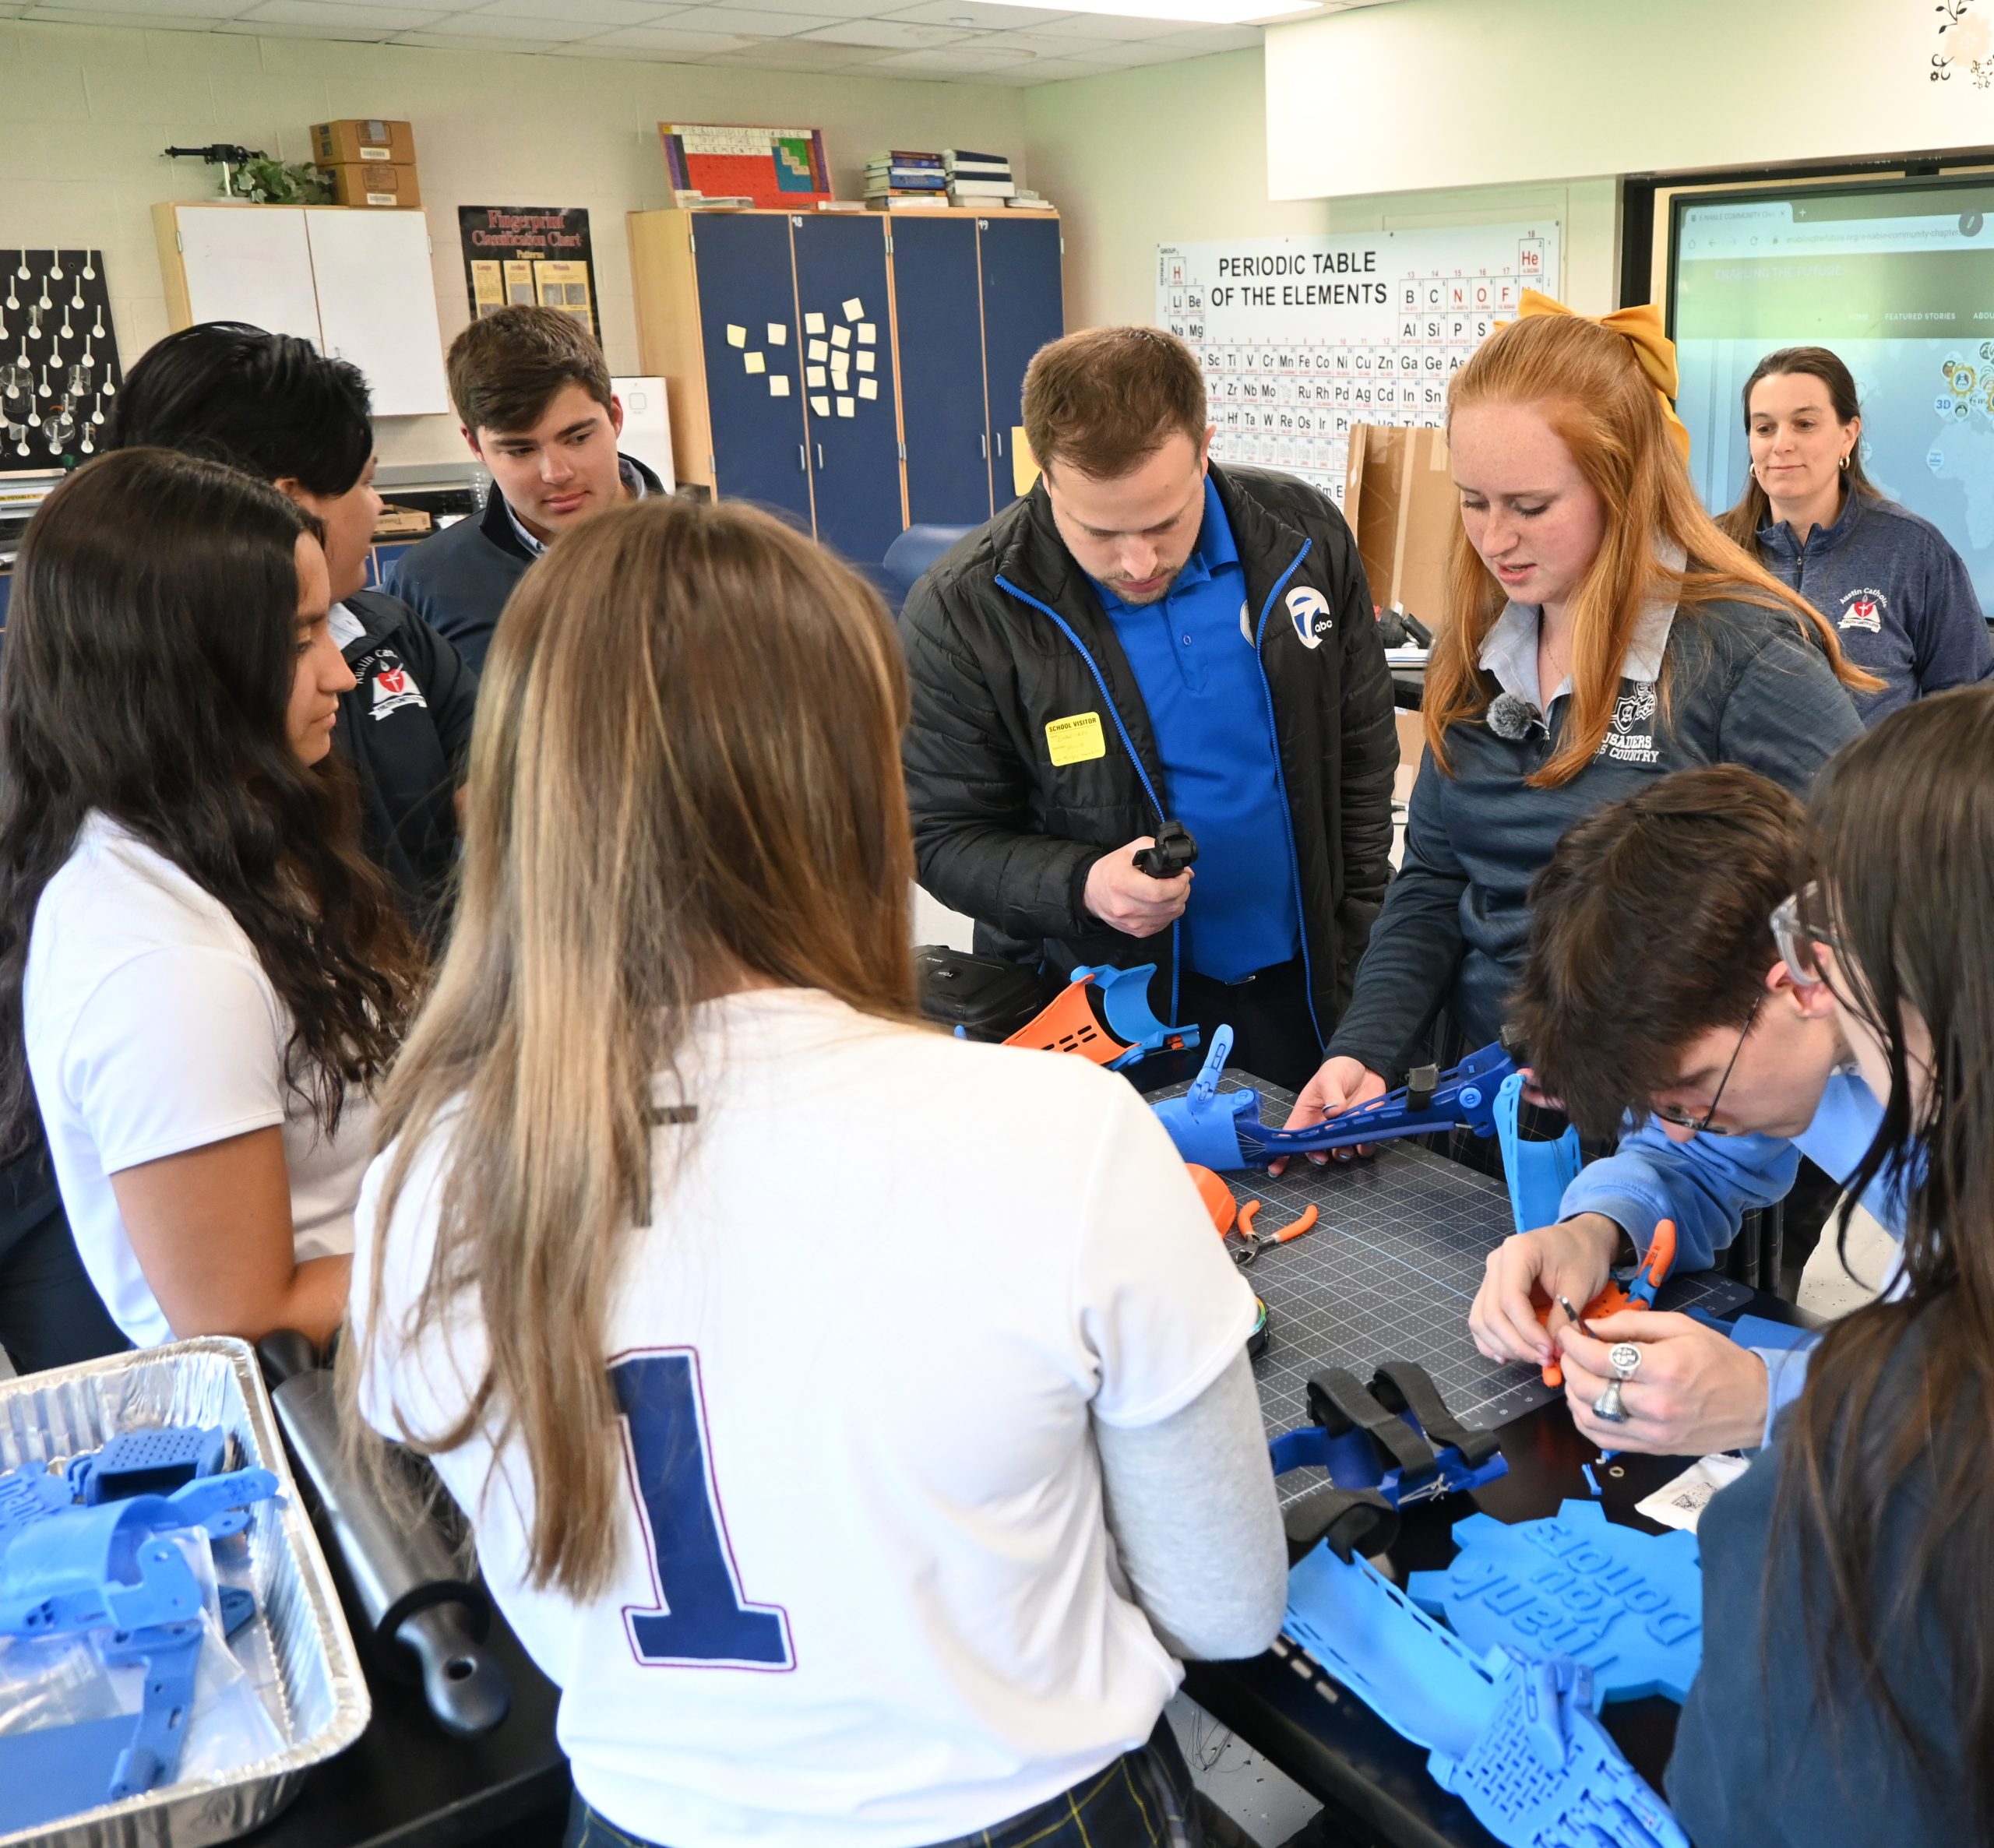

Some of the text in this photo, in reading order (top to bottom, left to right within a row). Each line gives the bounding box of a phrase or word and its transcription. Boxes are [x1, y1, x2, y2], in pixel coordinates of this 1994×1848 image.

[487, 209, 565, 233] Fingerprint
[792, 216, 803, 227] 48
[1724, 212, 1760, 220] COMMUNITY
[978, 220, 988, 231] 49
[471, 230, 582, 247] Classification Chart
[1219, 251, 1376, 277] PERIODIC TABLE
[1522, 251, 1538, 266] He
[1173, 266, 1181, 279] H
[1796, 265, 1841, 277] FUTURE
[1173, 295, 1201, 308] Li Be
[1211, 283, 1387, 306] OF THE ELEMENTS
[1406, 287, 1510, 304] B C N O F
[1171, 324, 1203, 338] Na Mg
[1404, 322, 1485, 336] Al Si P S
[1208, 354, 1465, 370] Sc Ti V Cr Mn Fe Co Ni Cu Zn Ga Ge As
[1211, 382, 1217, 395] Y
[1228, 383, 1238, 396] Zr
[1245, 384, 1257, 396] Nb
[1262, 385, 1276, 397] Mo
[1298, 386, 1311, 399] Ru
[1316, 386, 1330, 400] Rh
[1336, 387, 1349, 400] Pd
[1355, 388, 1371, 403] Ag
[1378, 388, 1393, 402] Cd
[1404, 389, 1414, 402] In
[1425, 389, 1441, 403] Sn
[1936, 400, 1950, 410] 3D
[1228, 412, 1238, 424] Hf
[1245, 413, 1256, 425] Ta
[1264, 414, 1274, 426] W
[1281, 414, 1293, 428] Re
[1298, 416, 1311, 428] Os
[1319, 417, 1326, 430] Ir
[1337, 417, 1348, 431] Pt
[1337, 486, 1344, 498] E
[1840, 587, 1888, 608] Austin Catholic
[1315, 620, 1333, 632] abc
[1048, 717, 1097, 733] SCHOOL VISITOR
[1601, 732, 1652, 749] USADERS
[1609, 748, 1659, 763] COUNTRY
[605, 1345, 797, 1673] 1
